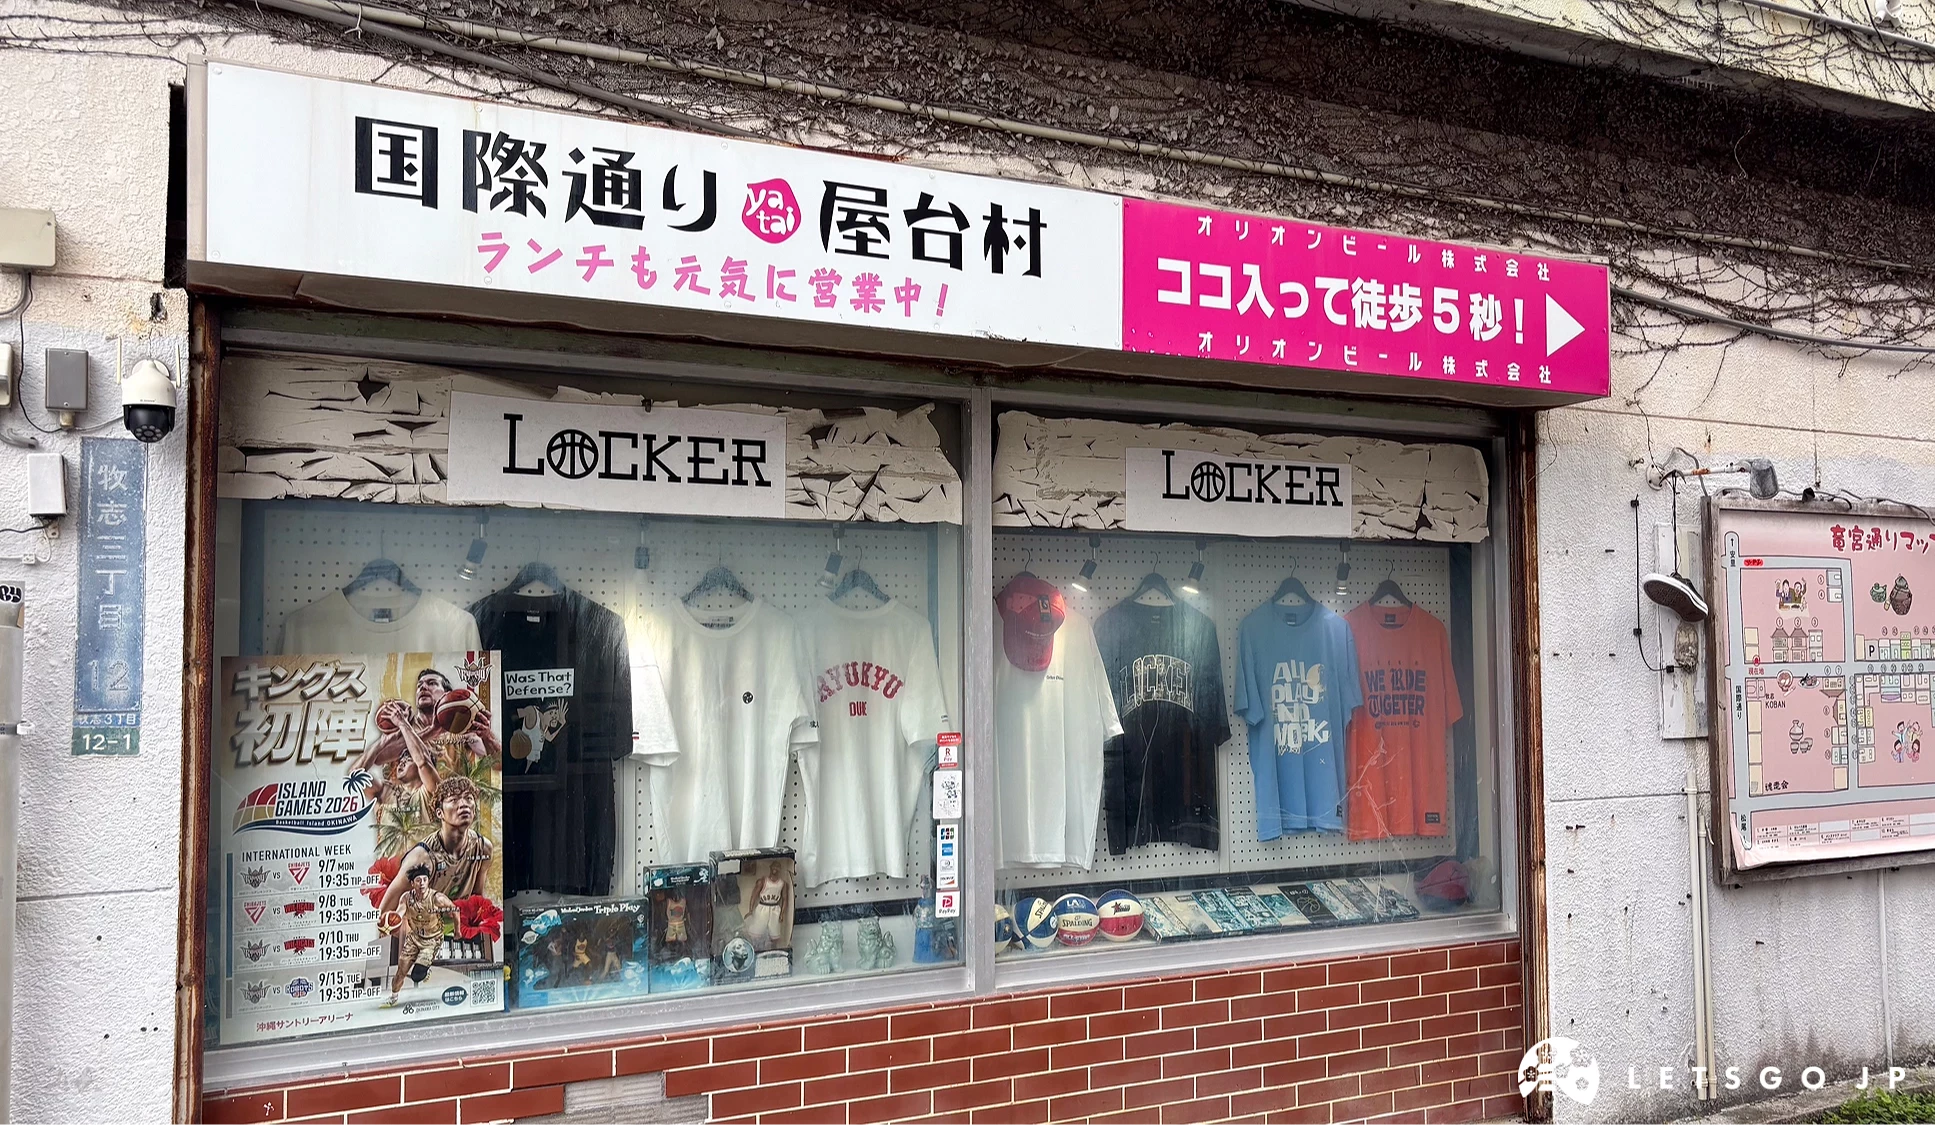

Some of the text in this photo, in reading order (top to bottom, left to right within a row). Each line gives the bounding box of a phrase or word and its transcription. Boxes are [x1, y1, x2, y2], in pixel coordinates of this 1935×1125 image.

[355, 116, 717, 232] 国際通り
[747, 187, 783, 213] ya
[757, 206, 795, 236] tai
[820, 180, 1047, 278] 屋台村
[1197, 216, 1551, 282] オリオンビール株式会社
[1197, 332, 1552, 385] オリオンビール株式会社
[1869, 645, 1875, 657] P
[87, 660, 130, 692] 12
[233, 660, 367, 700] キングス
[506, 671, 572, 684] Was That
[817, 661, 905, 702] RYUKYU
[1364, 669, 1386, 692] WE
[506, 682, 572, 697] Defense?
[231, 700, 372, 766] 初陣
[82, 733, 132, 751] 12-1
[278, 781, 327, 799] ISLAND
[275, 796, 359, 817] GAMES 2026
[242, 844, 352, 862] INTERNATIONAL WEEK
[319, 859, 355, 873] 9/7 MON
[272, 871, 281, 879] VS
[319, 874, 380, 889] 19:35 TIP-OFF
[319, 894, 353, 908] 9/8 TUE
[619, 902, 641, 913] Play
[272, 907, 281, 915] VS
[319, 909, 349, 924] 19:35
[351, 910, 380, 921] TIP-OFF
[1062, 918, 1093, 927] SPALDING
[319, 931, 359, 945] 9/10 THU
[272, 945, 281, 953] VS
[319, 945, 380, 960] 19:35 TIP-OFF
[319, 972, 360, 986] 9/15 TUE
[272, 987, 281, 995] VS
[319, 987, 381, 1002] 19:35 TIP-OFF
[256, 1012, 354, 1032] 沖縄サントリーアリーナ
